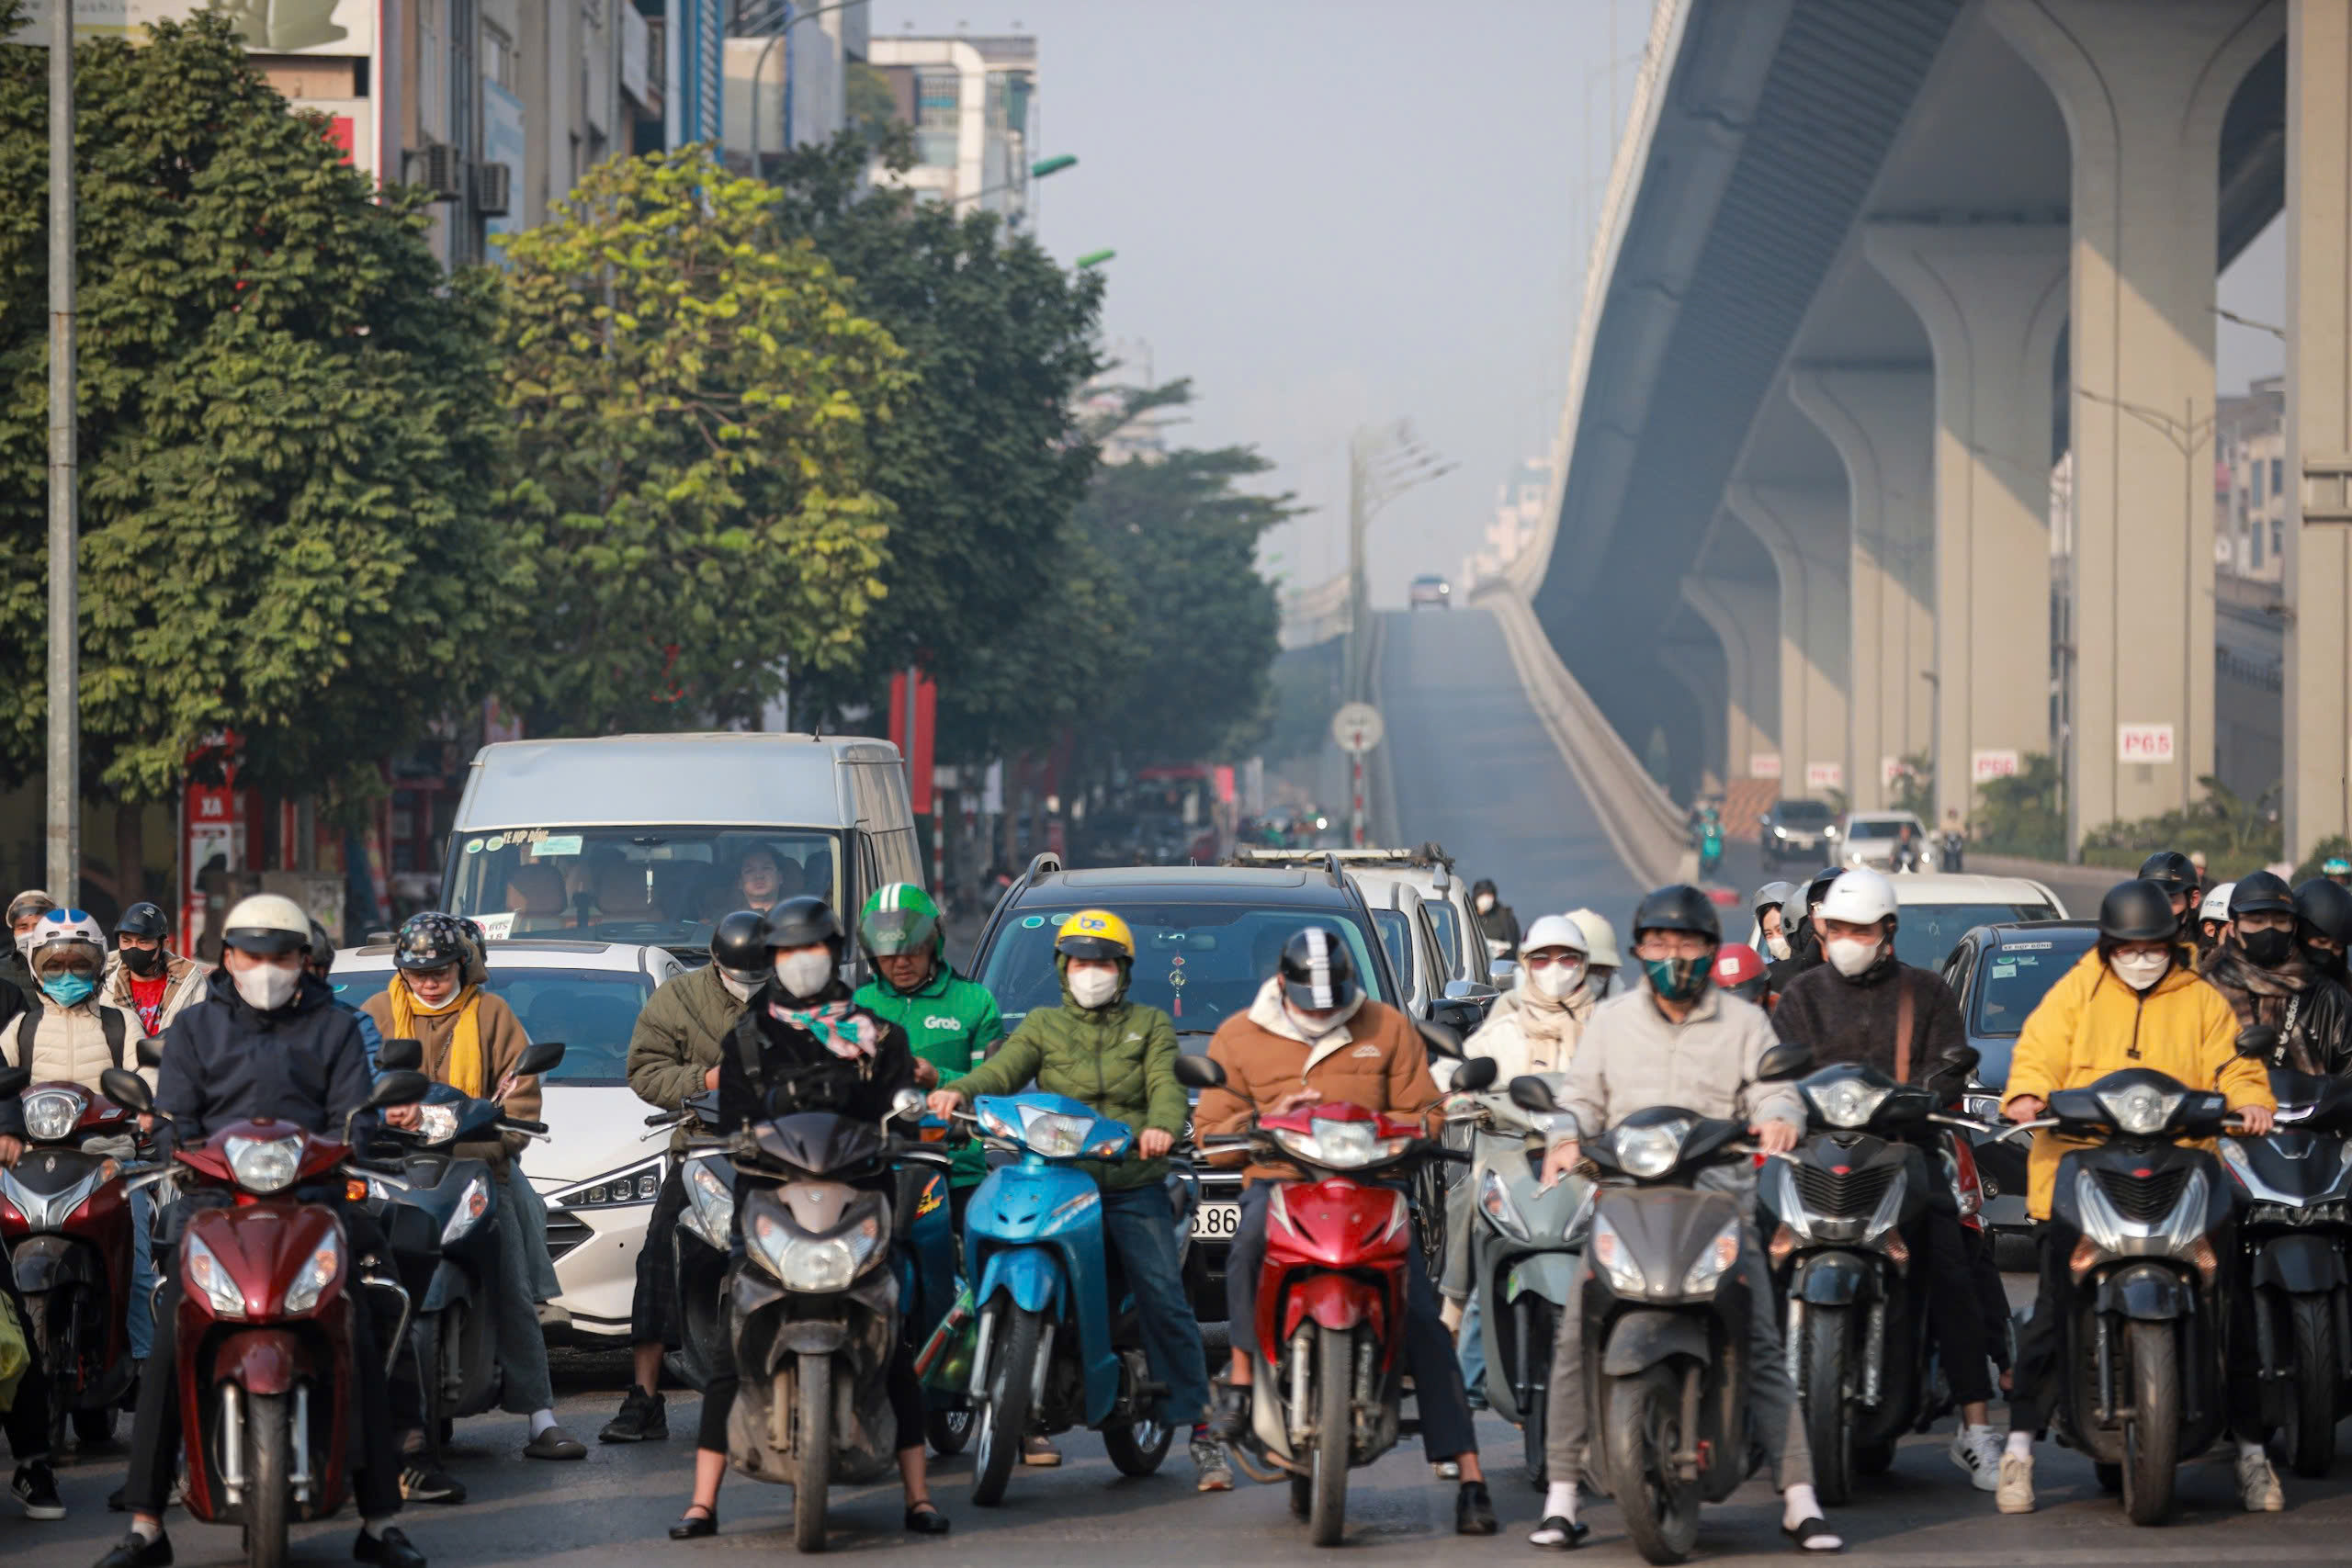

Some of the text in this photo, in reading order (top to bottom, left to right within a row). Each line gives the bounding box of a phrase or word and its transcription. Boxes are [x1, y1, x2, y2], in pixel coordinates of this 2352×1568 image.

[2124, 732, 2171, 754] P65
[1080, 915, 1106, 931] be
[876, 929, 906, 942] Grab
[2284, 993, 2301, 1032] adidas
[923, 1015, 962, 1031] Grab
